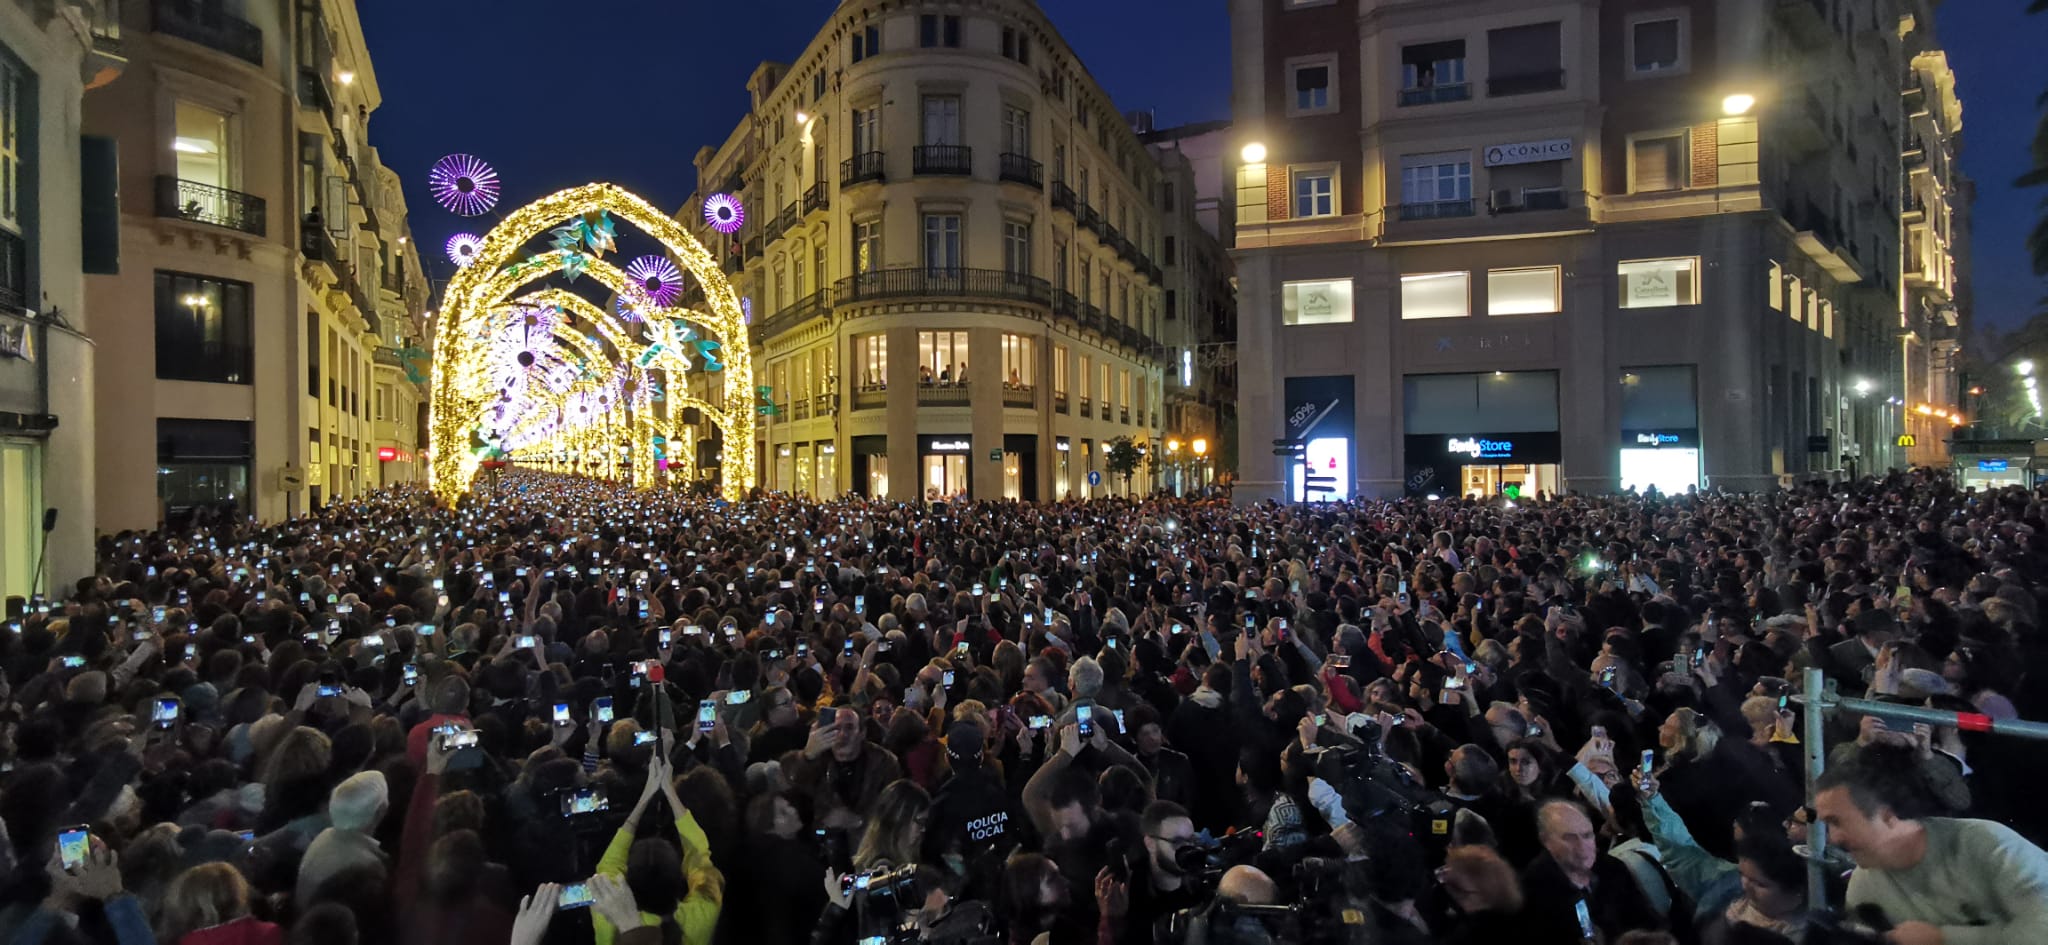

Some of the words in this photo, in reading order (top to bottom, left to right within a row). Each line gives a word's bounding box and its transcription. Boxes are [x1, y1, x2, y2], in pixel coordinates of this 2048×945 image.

[1508, 142, 1570, 156] CÓNICO
[1289, 402, 1315, 427] 50%
[967, 811, 1008, 831] POLICIA
